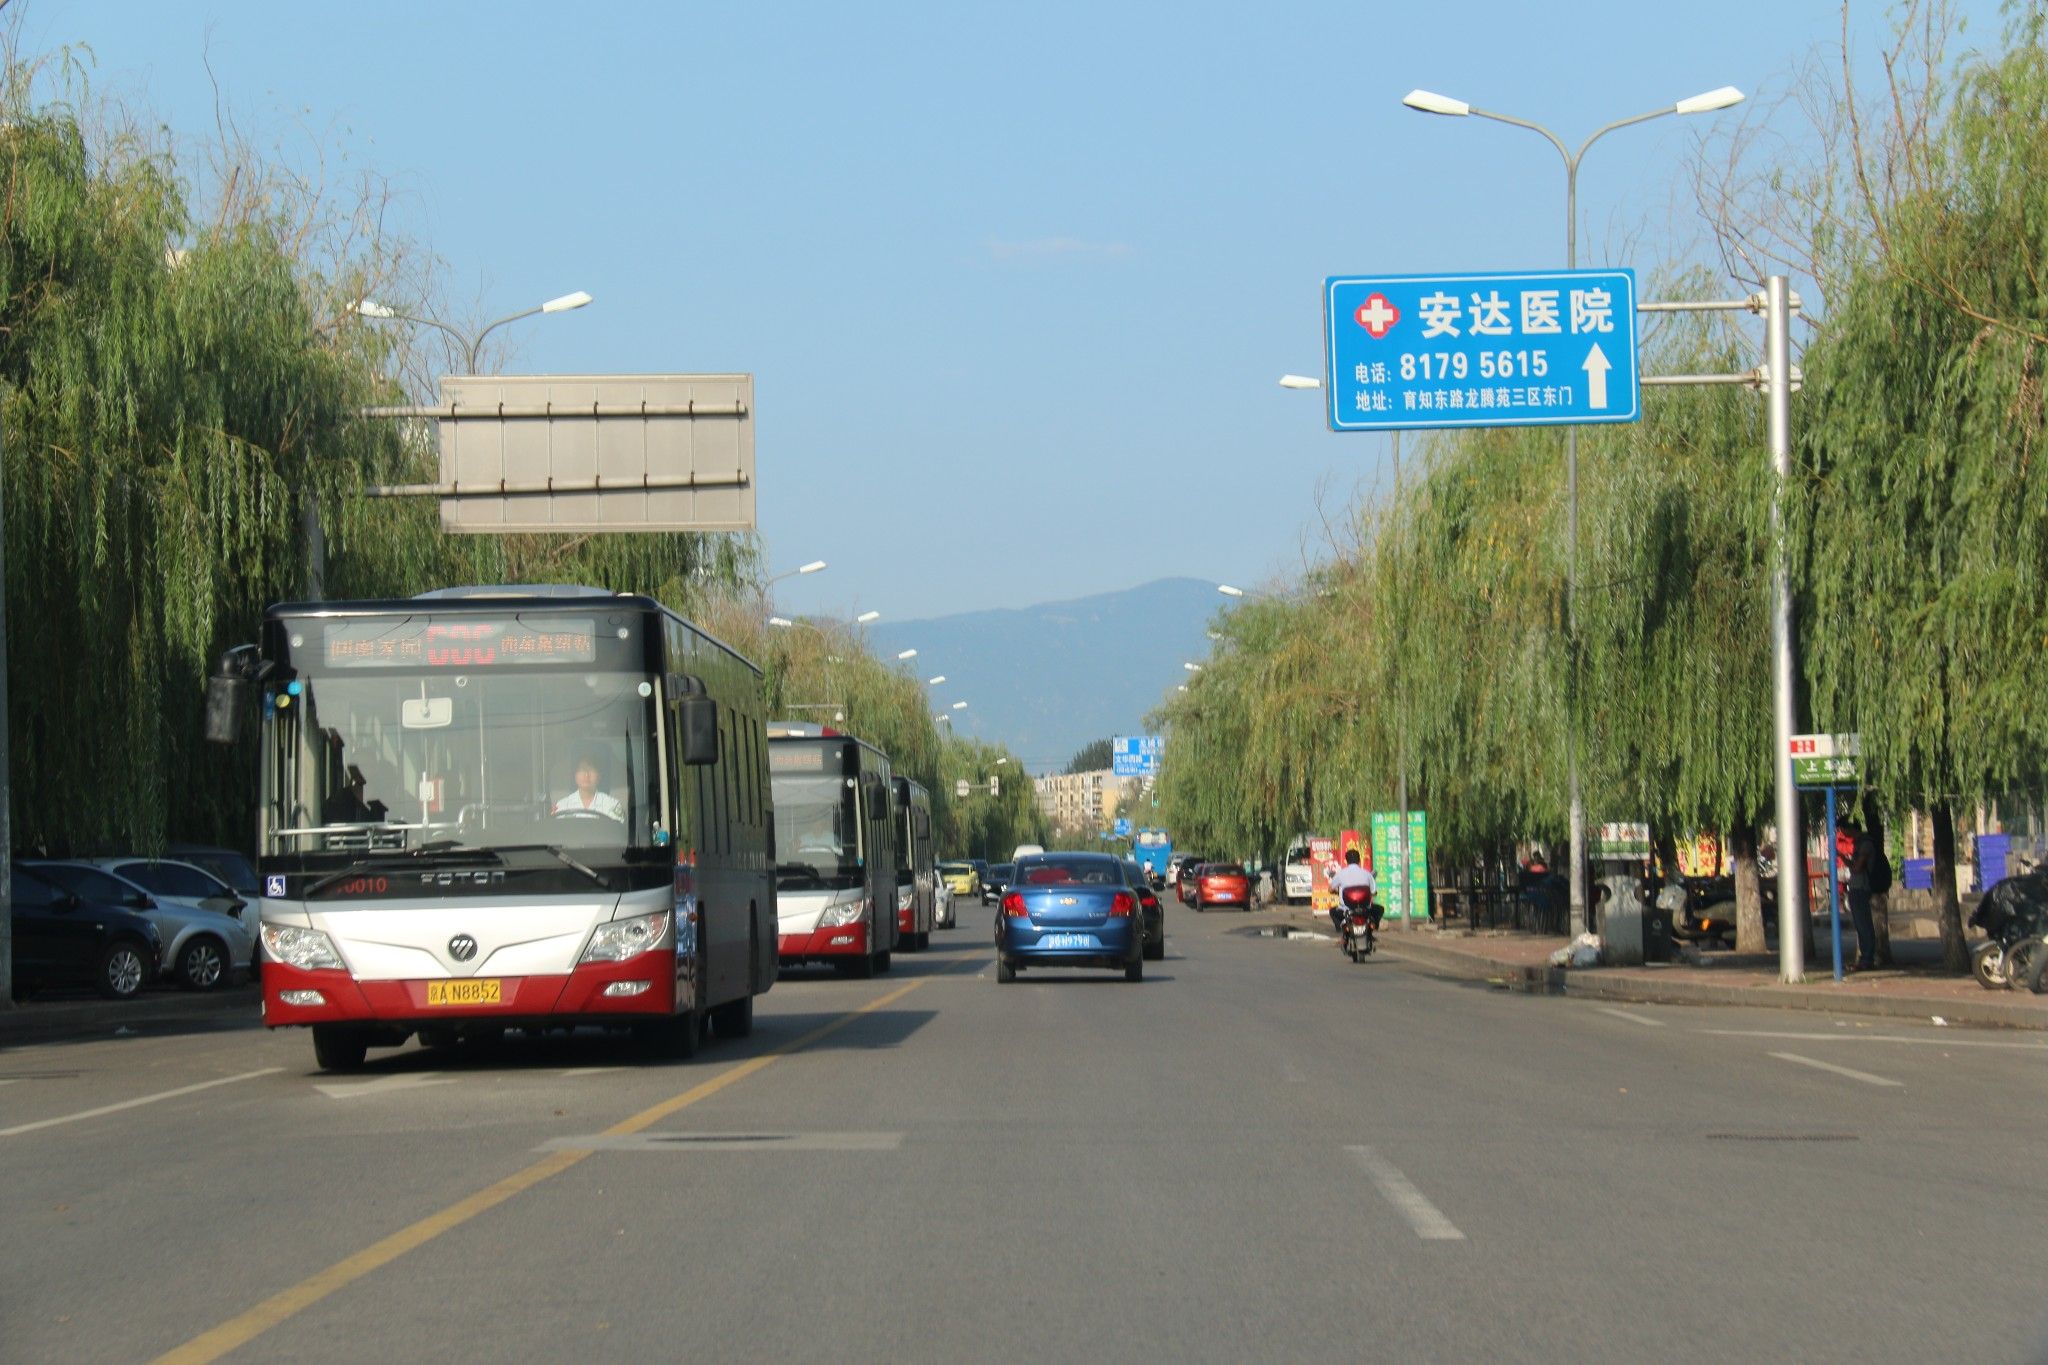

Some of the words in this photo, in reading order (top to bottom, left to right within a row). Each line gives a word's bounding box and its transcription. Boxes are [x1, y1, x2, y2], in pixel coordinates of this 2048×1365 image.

[1419, 287, 1614, 338] 安达医院
[1400, 352, 1468, 380] 8179
[1480, 350, 1548, 378] 5615
[1403, 386, 1572, 410] 育知东路龙腾苑三区东门
